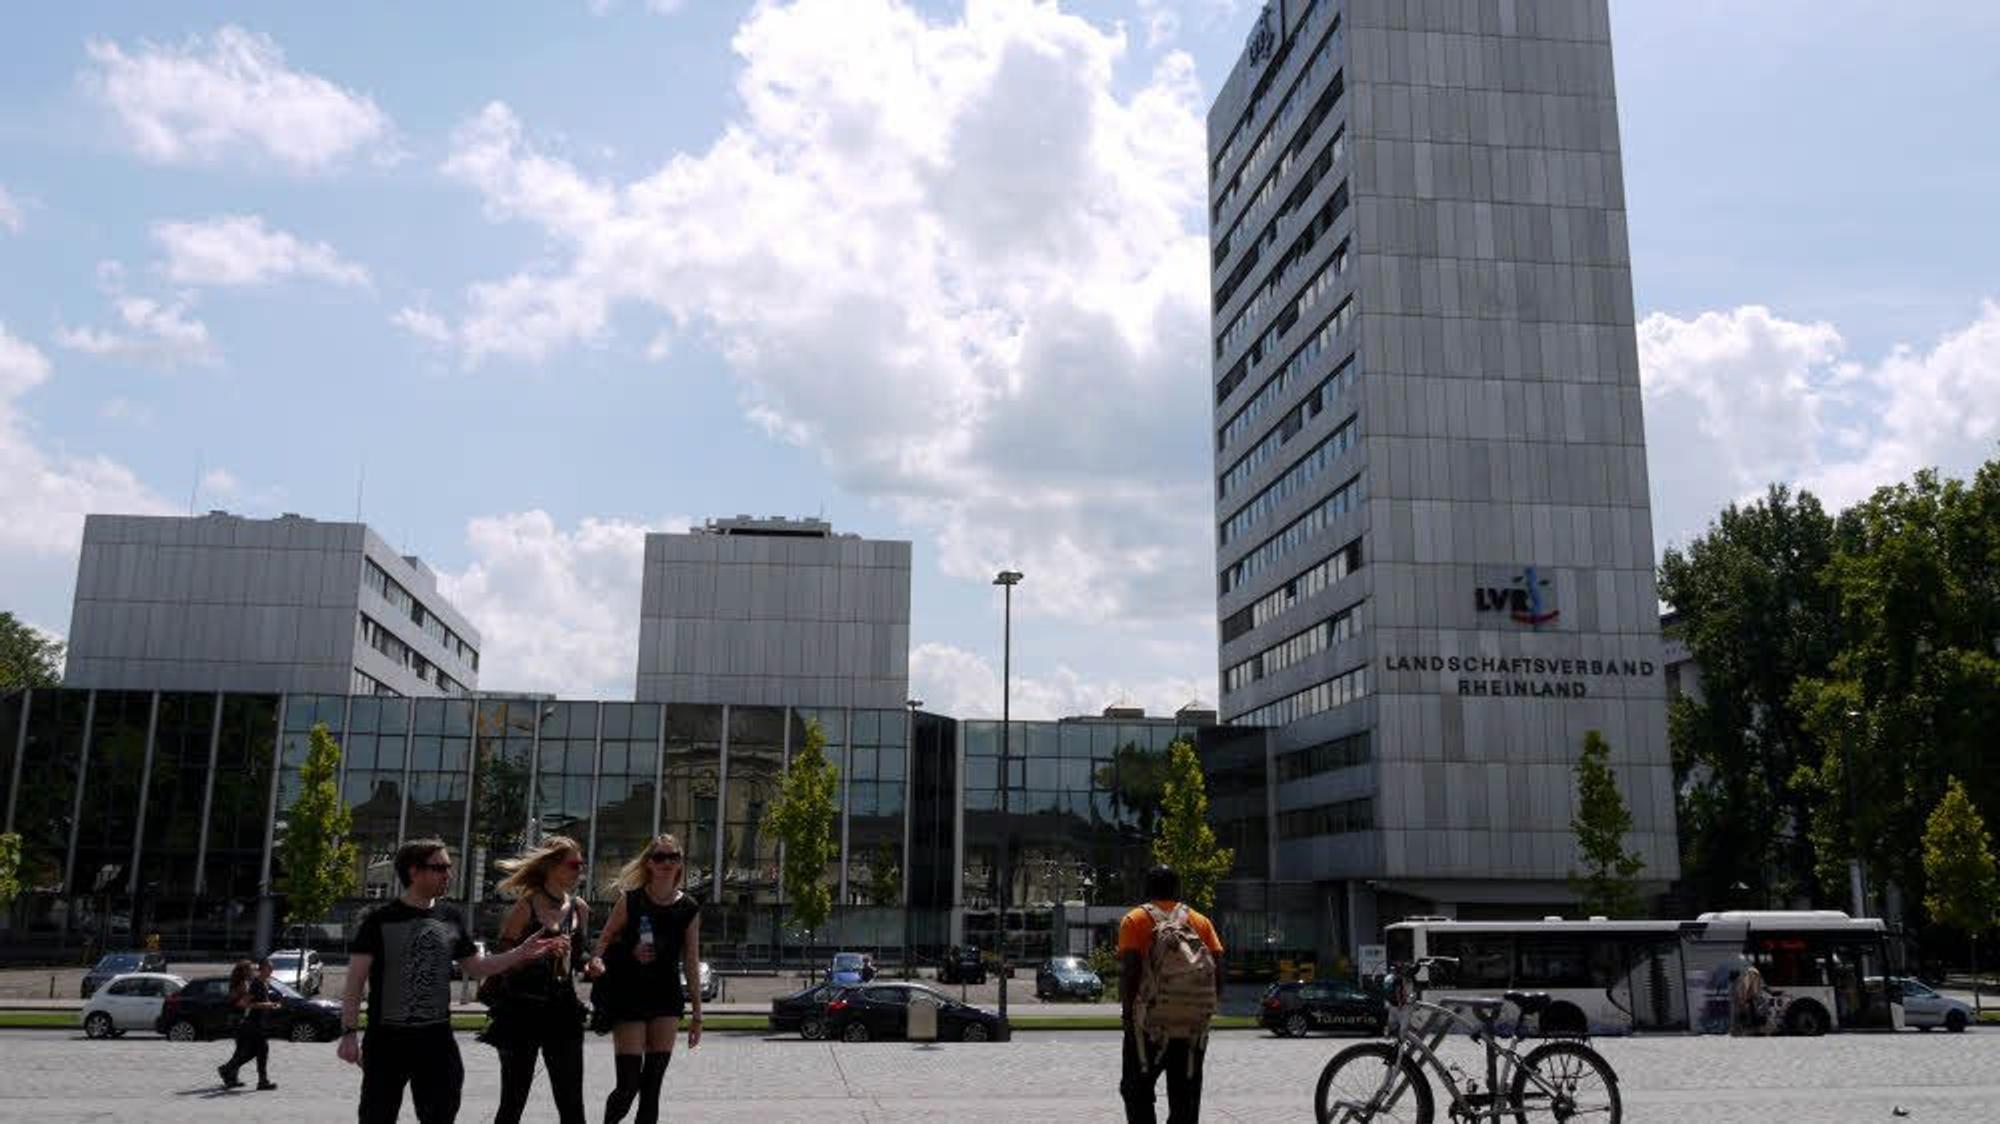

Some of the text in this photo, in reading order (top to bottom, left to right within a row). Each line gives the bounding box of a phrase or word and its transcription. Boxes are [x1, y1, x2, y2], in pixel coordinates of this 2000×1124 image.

[1475, 588, 1529, 613] LVR
[1386, 656, 1654, 676] LANDSCHAFTSVERBAND
[1458, 680, 1587, 698] RHEINLAND
